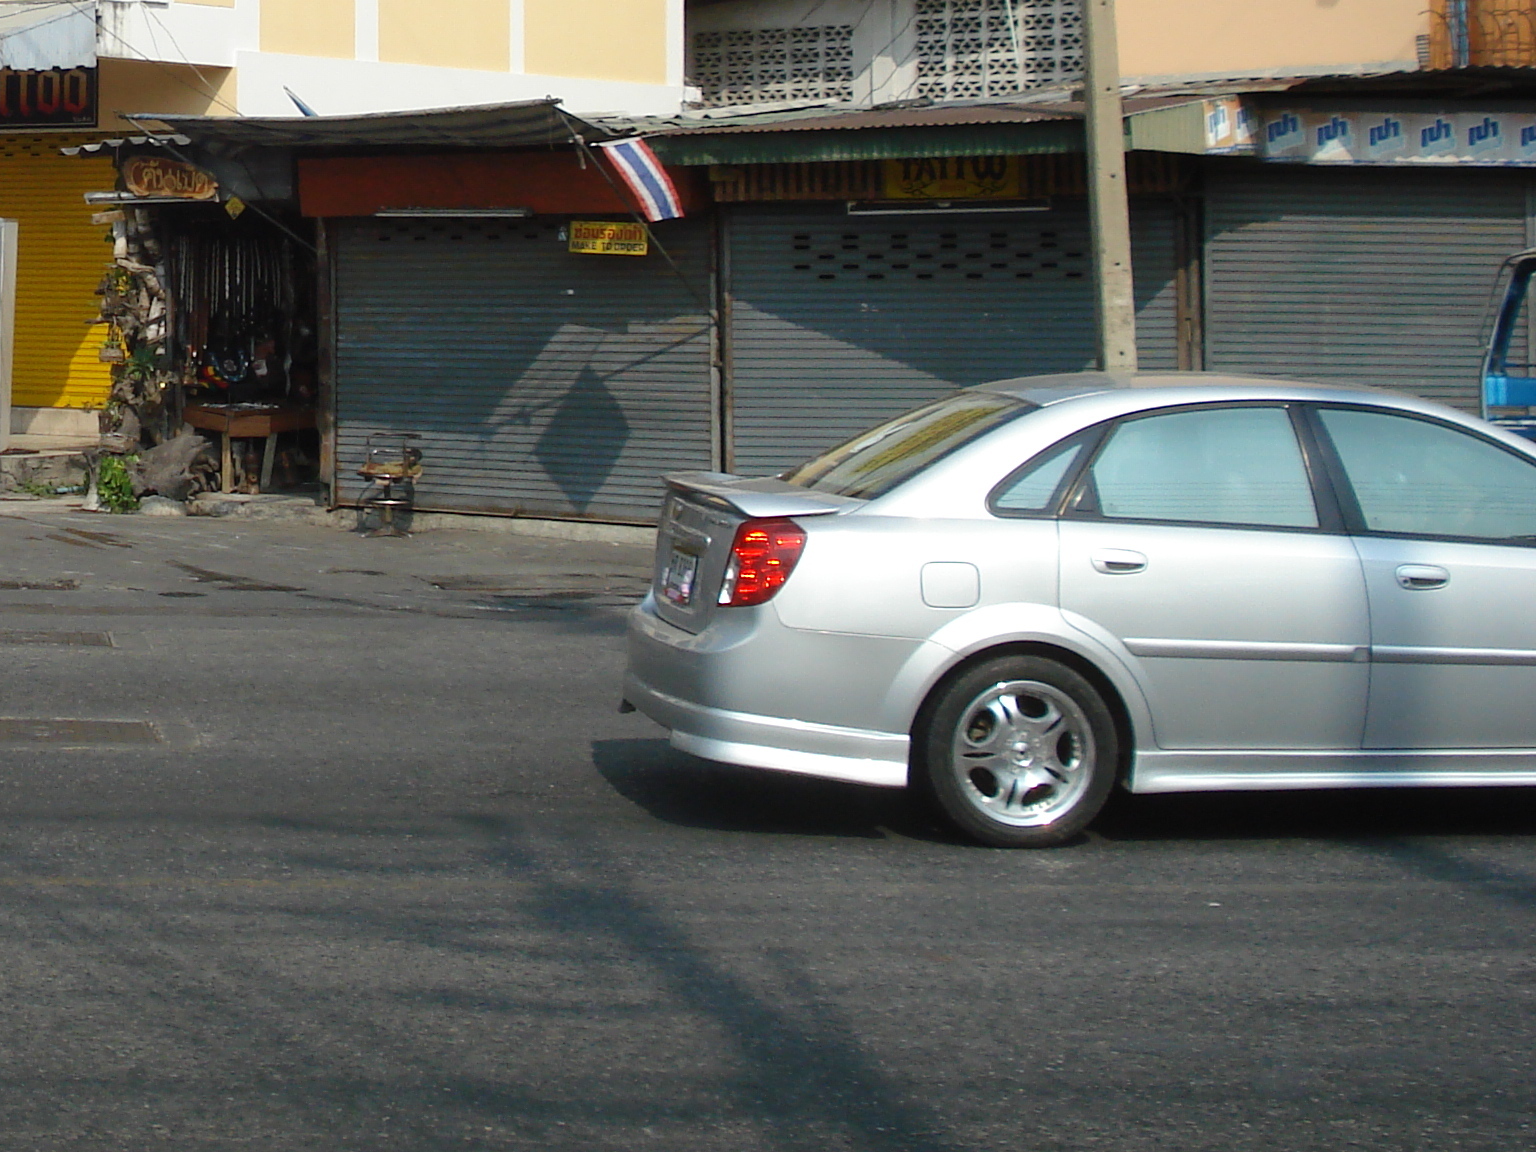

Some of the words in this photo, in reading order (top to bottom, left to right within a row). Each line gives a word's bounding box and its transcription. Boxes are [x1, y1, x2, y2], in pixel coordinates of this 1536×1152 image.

[572, 241, 597, 250] MAKE
[601, 242, 612, 251] TO
[614, 242, 644, 252] ORDER
